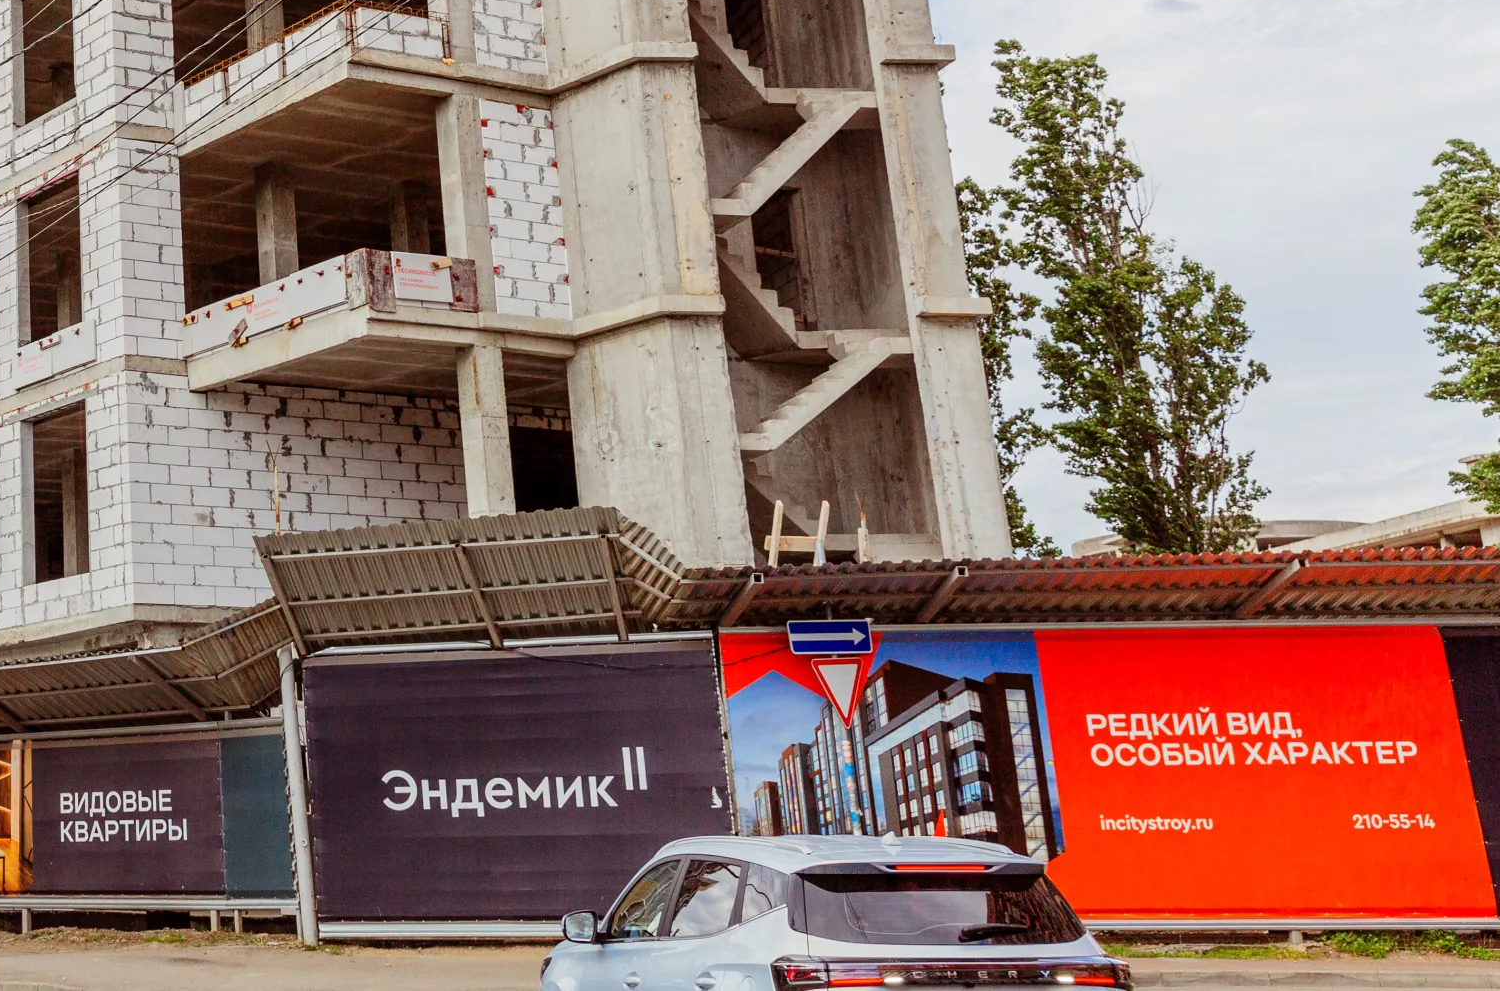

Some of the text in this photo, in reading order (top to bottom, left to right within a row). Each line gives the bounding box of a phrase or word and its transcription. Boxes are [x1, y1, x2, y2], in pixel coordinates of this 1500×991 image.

[1086, 707, 1302, 740] РЕДКИЙ ВИД,
[1090, 737, 1418, 767] ОСОБЫЙ ХАРАКТЕР
[60, 789, 173, 817] ВИДОВЫЕ
[381, 769, 619, 818] Эндемик
[60, 818, 188, 842] КВАРТИРЫ
[1100, 814, 1214, 834] incitystroy.ru
[1352, 813, 1436, 829] 210-55-14
[912, 969, 1051, 980] CHERY
